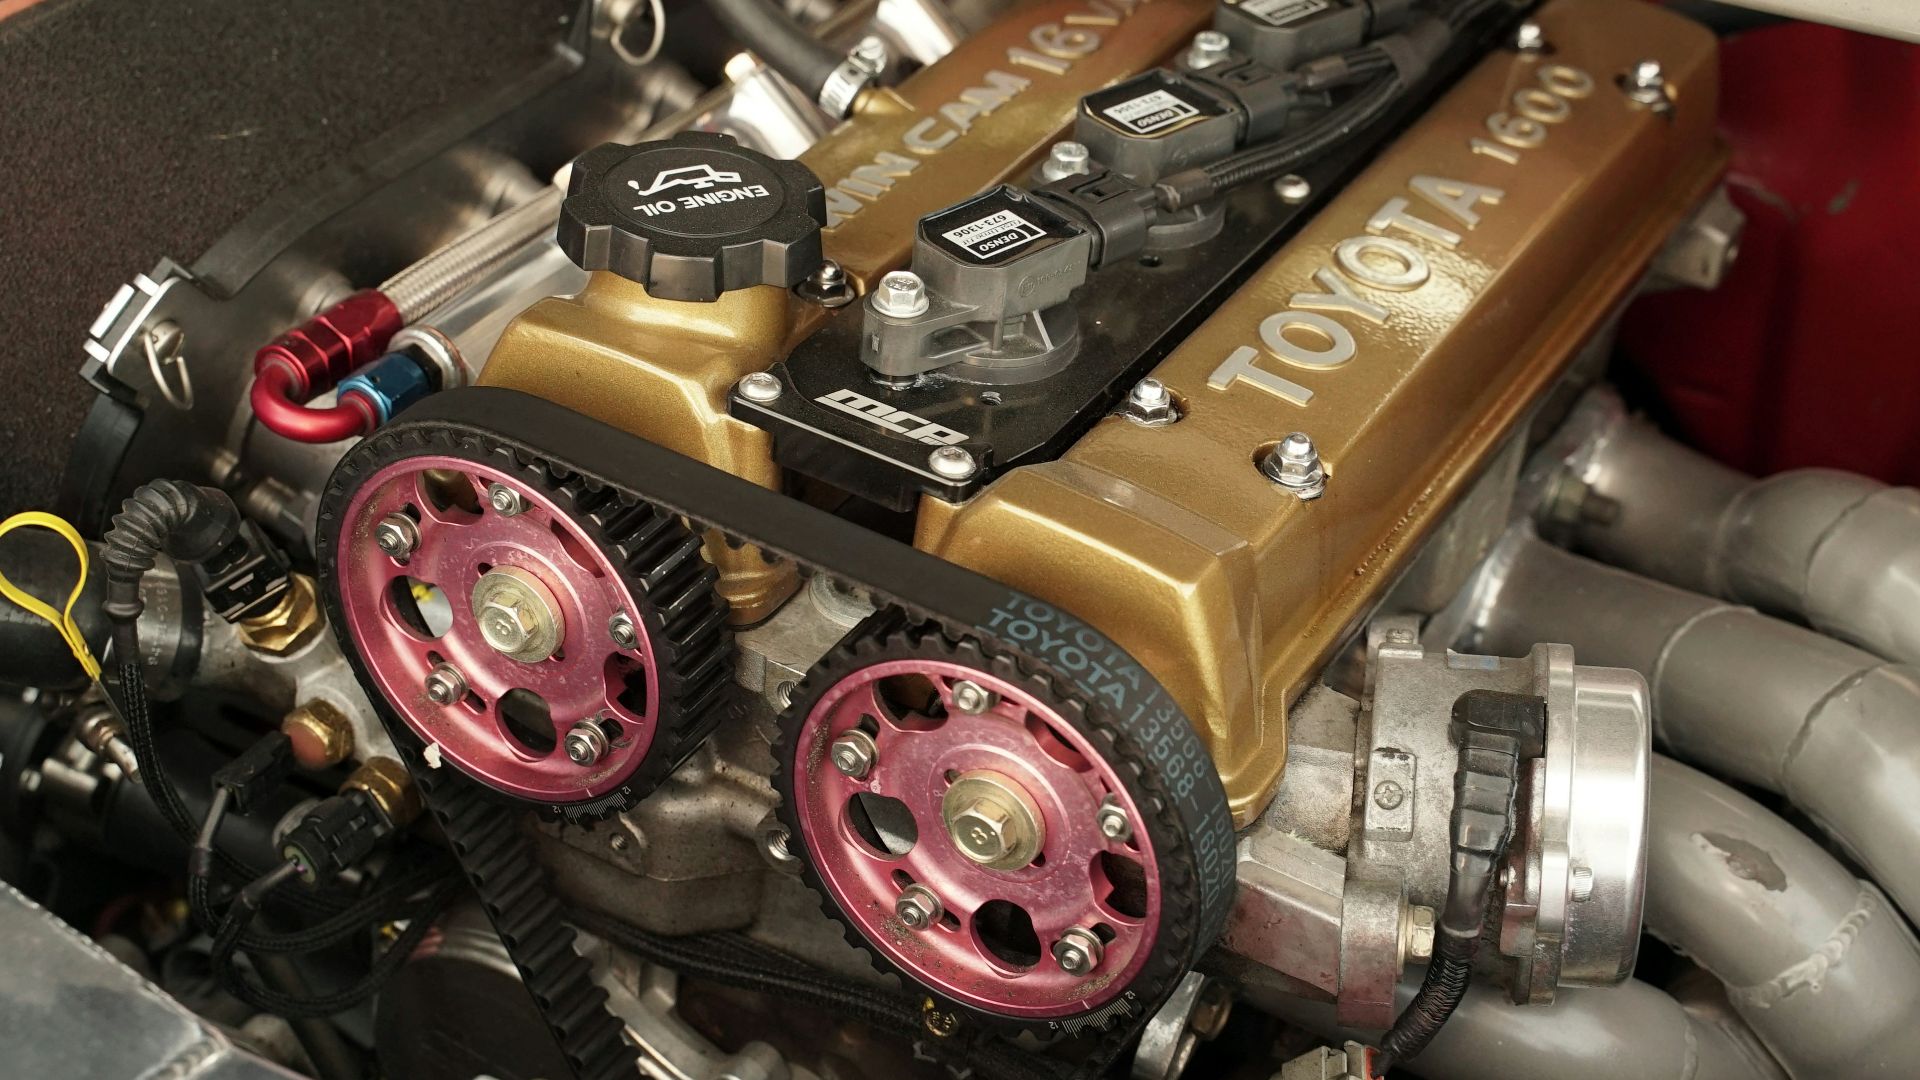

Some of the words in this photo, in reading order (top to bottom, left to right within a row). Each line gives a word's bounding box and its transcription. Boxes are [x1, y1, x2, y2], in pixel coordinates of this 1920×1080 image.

[821, 151, 920, 232] WIN
[903, 70, 1031, 154] CAM
[633, 200, 676, 216] OIL
[677, 185, 770, 209] ENGINE
[953, 214, 1007, 238] 673-1306
[979, 232, 1019, 252] DENSO
[1207, 174, 1505, 408] TOYOTA
[1470, 65, 1595, 166] 1600
[990, 608, 1125, 710] TOYOTA
[1007, 591, 1141, 698] TOYOTA
